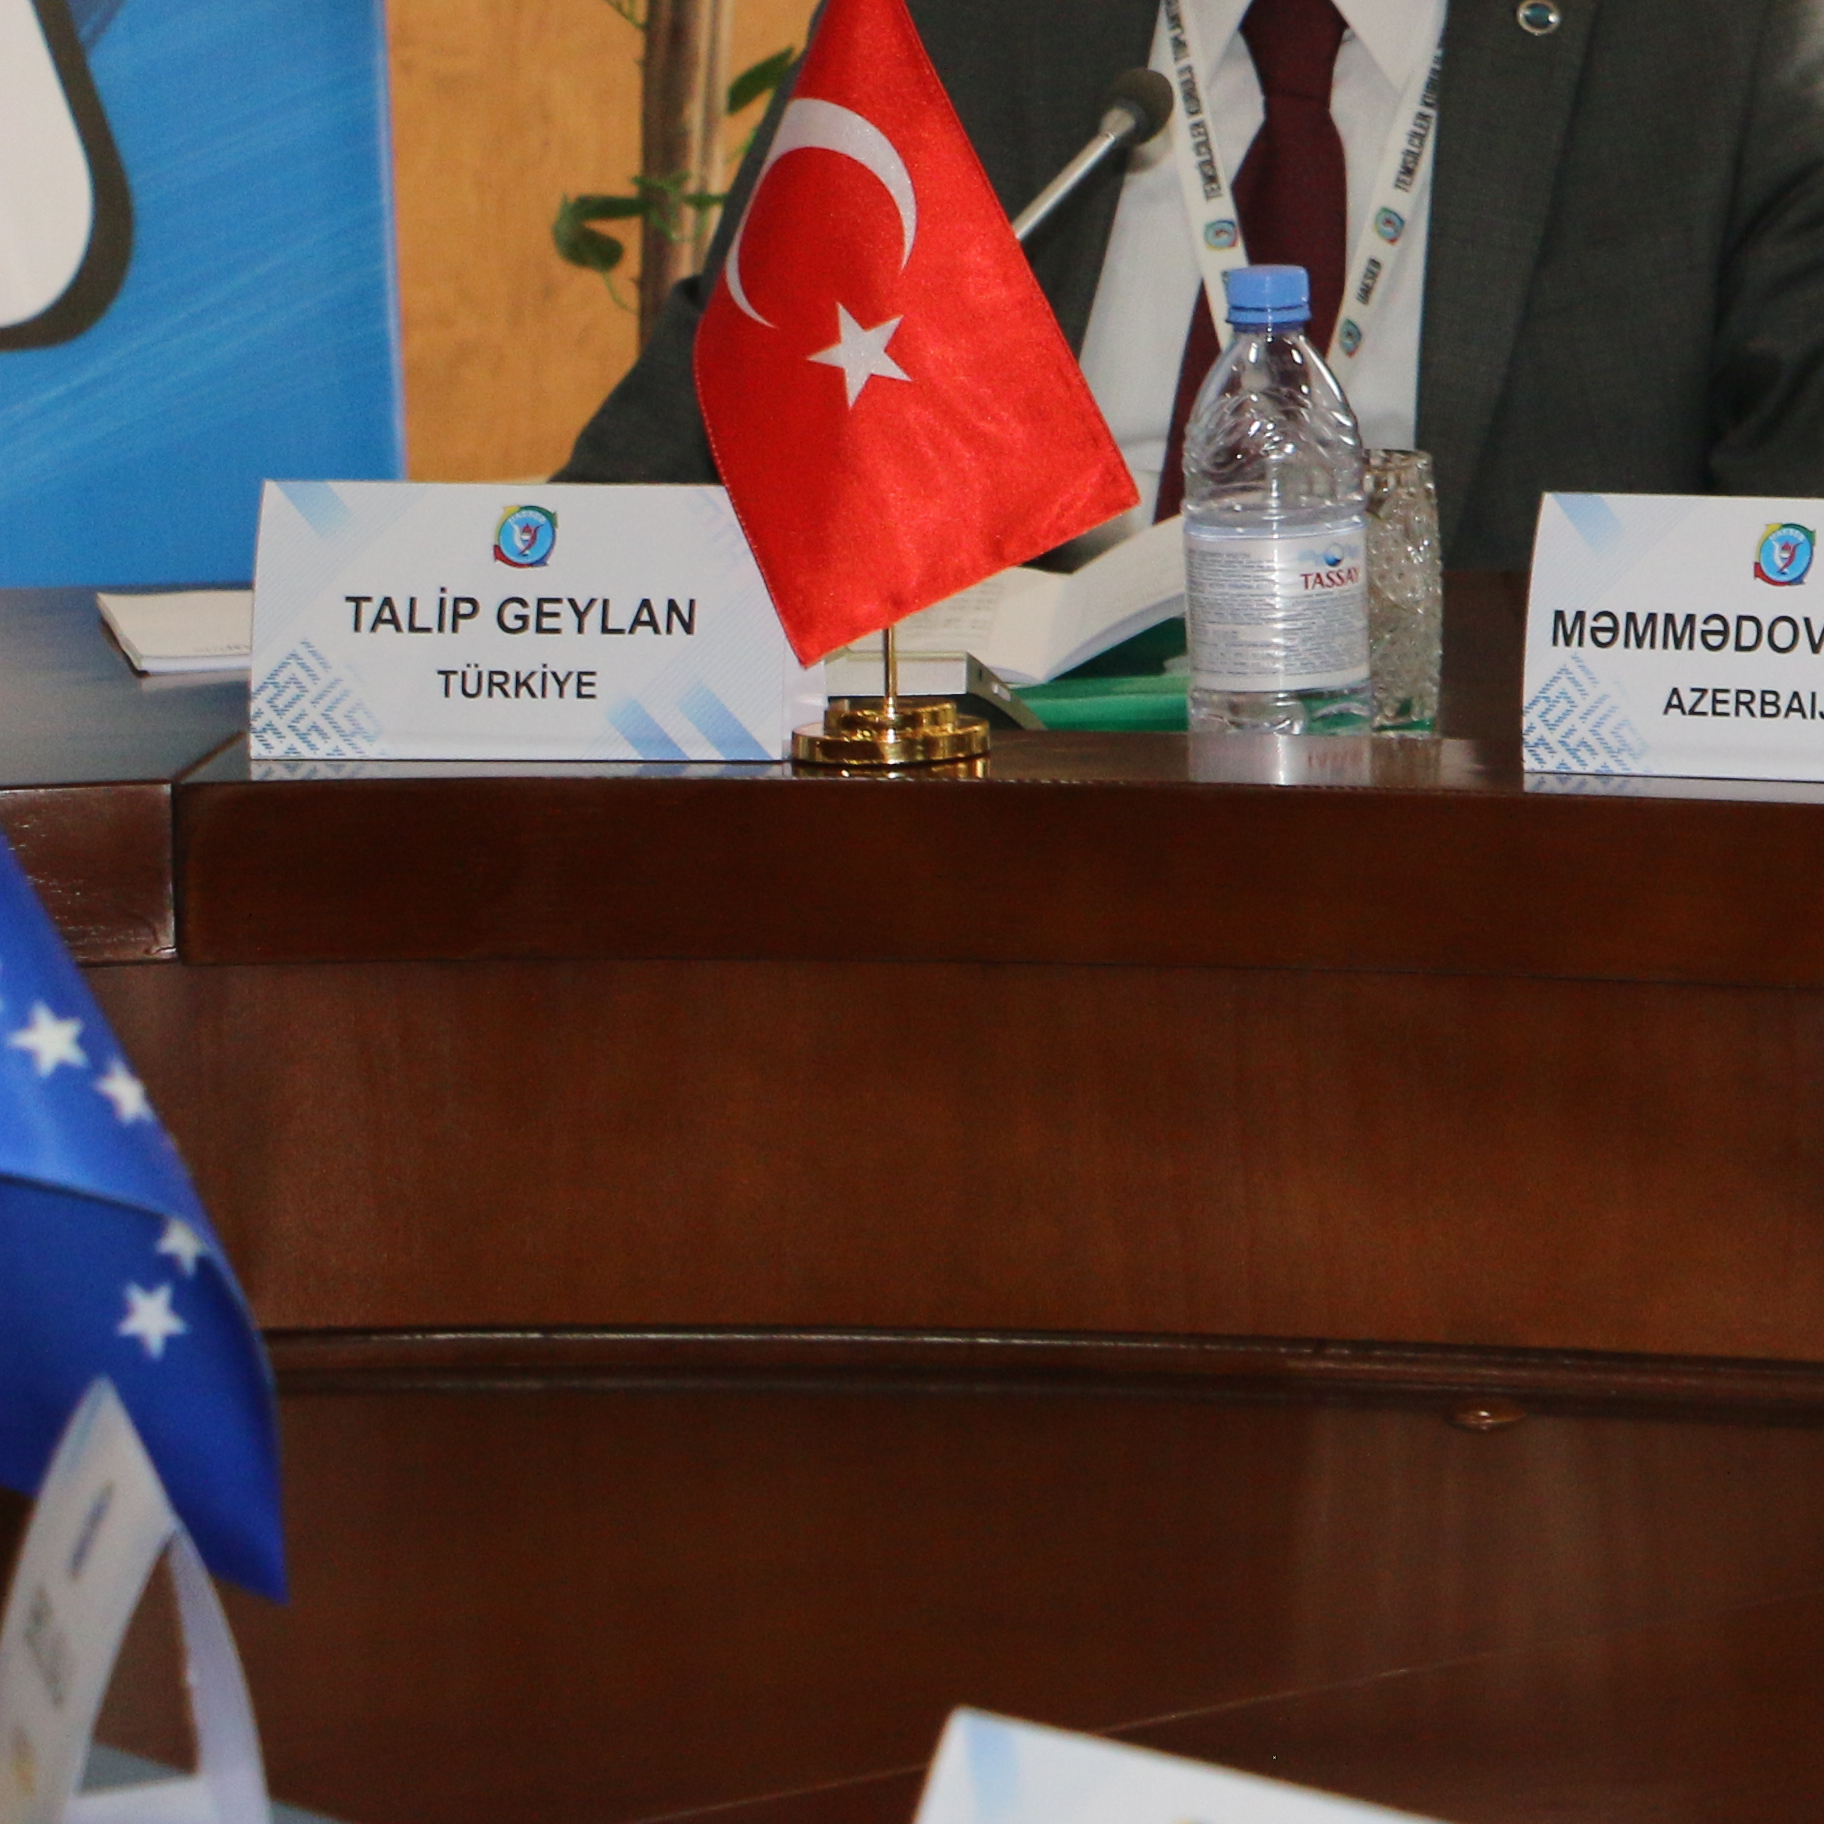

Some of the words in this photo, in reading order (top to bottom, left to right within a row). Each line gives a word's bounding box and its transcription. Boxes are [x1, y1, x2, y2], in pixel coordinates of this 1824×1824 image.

[345, 586, 480, 635] TALİP
[496, 596, 696, 636] GEYLAN
[437, 662, 598, 700] TÜRKİYE
